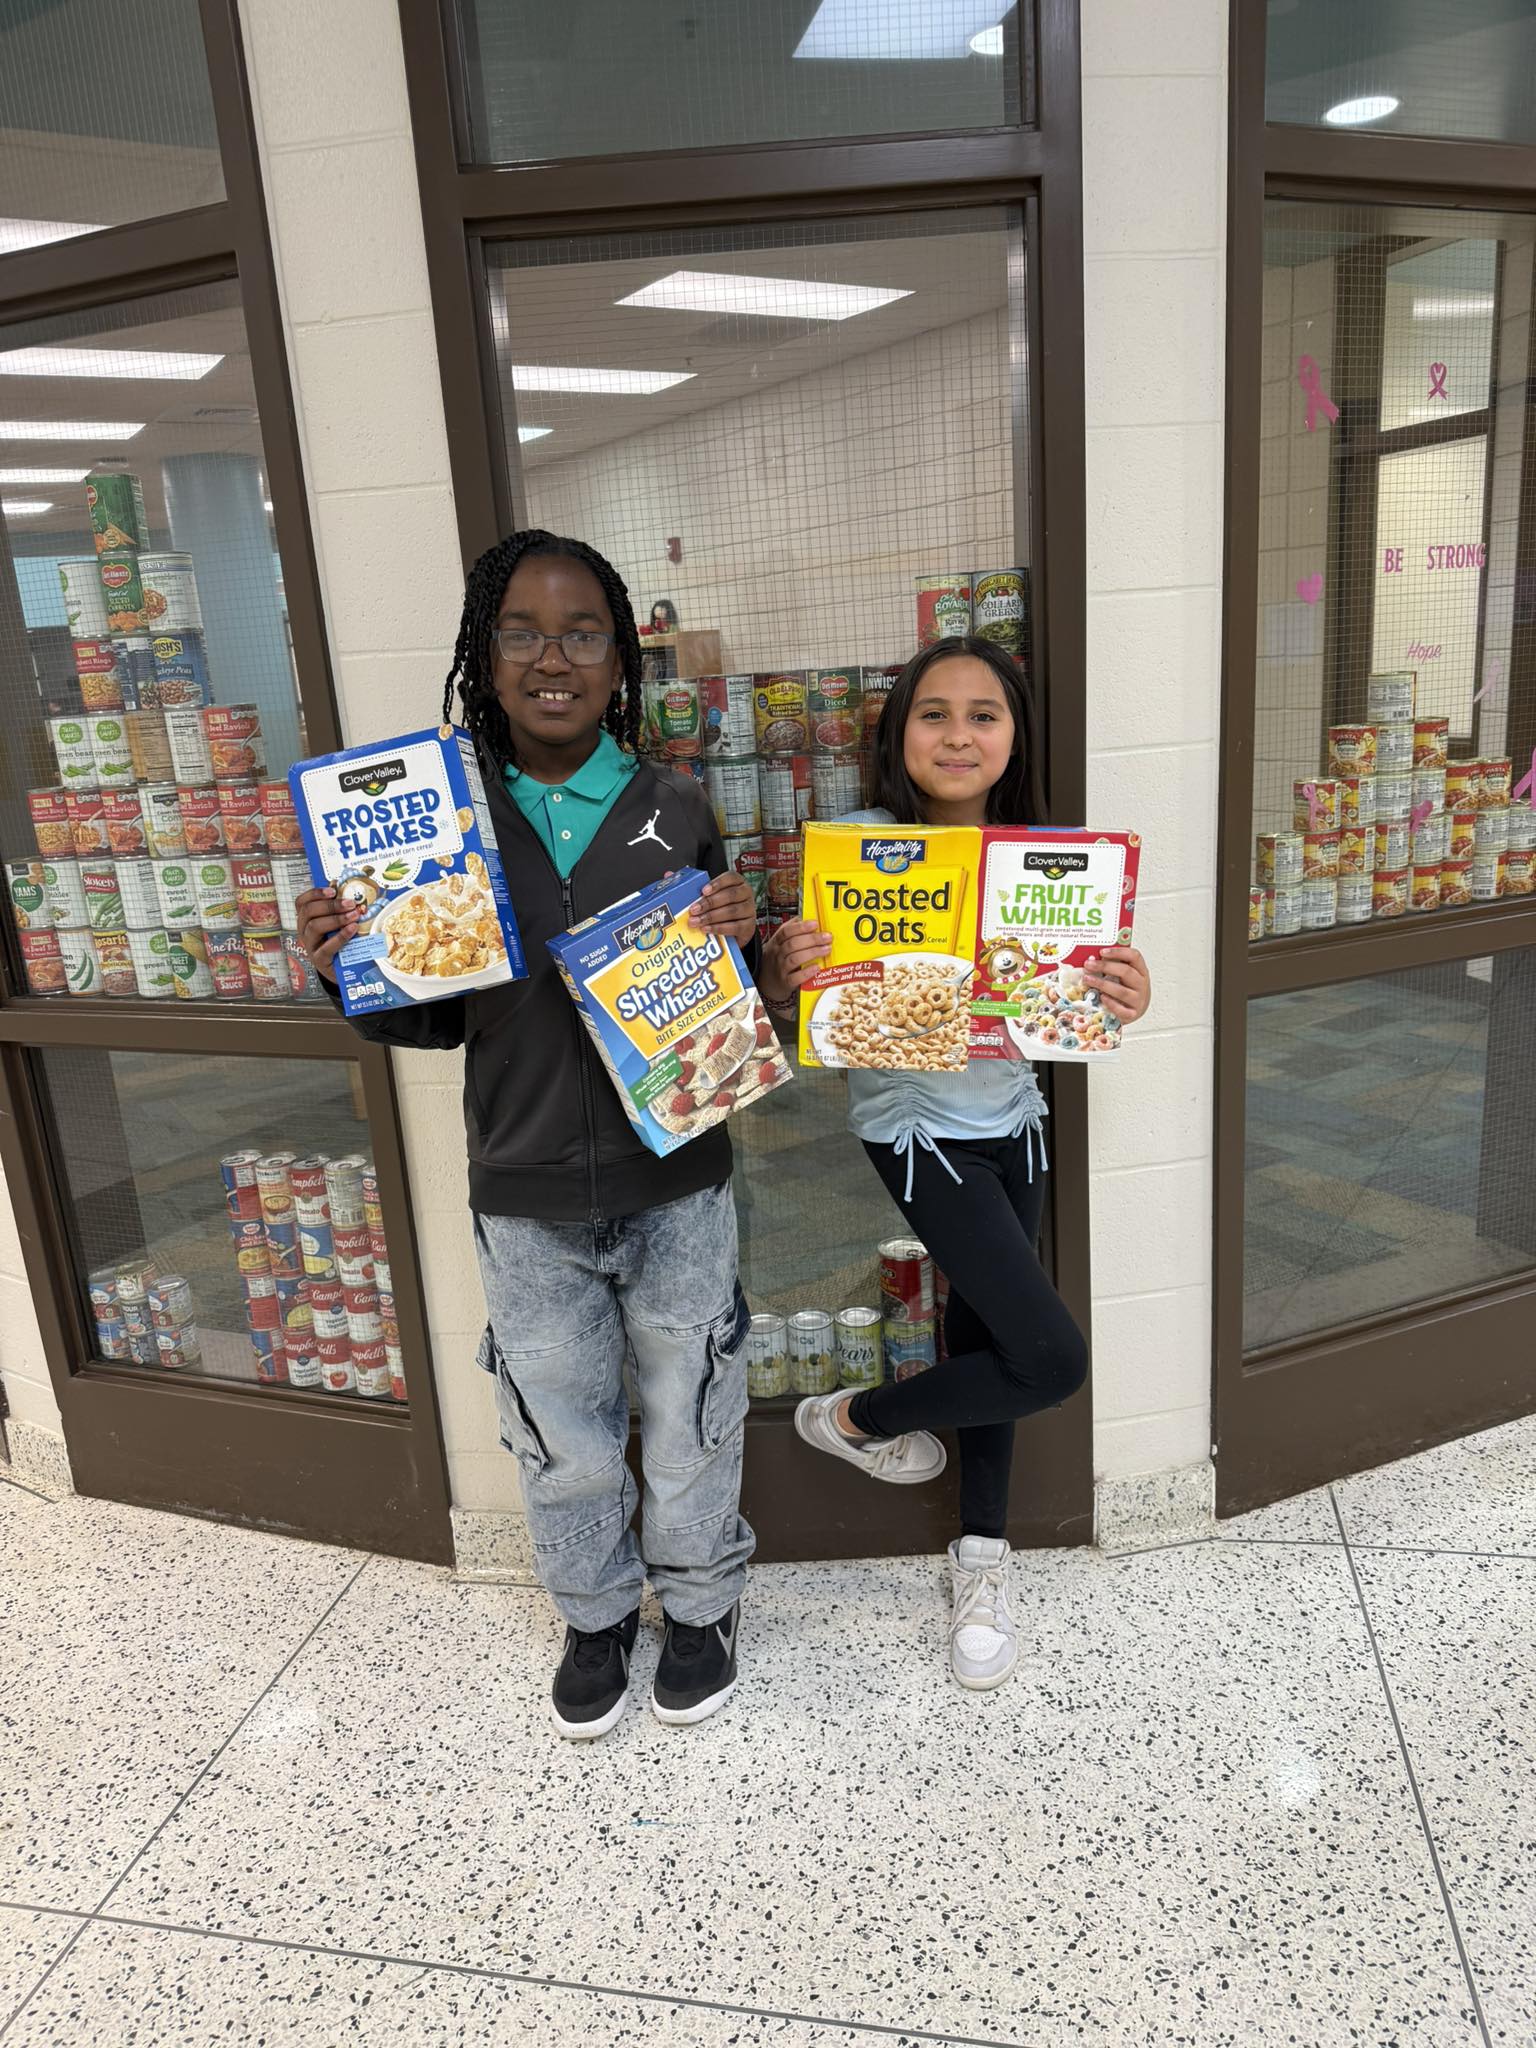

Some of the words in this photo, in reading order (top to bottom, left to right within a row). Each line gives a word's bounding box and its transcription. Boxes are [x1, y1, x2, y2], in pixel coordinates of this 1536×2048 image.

[1384, 548, 1404, 573] BE
[1427, 543, 1487, 571] STRONG
[981, 598, 1023, 610] COLLARD
[984, 607, 1021, 618] GREENS
[1407, 640, 1441, 665] Hope
[864, 676, 897, 690] ANWIC
[824, 698, 847, 706] Diced
[343, 771, 374, 786] Clover
[374, 765, 402, 778] Valley
[322, 788, 440, 836] FROSTED
[337, 815, 438, 859] FLAKES
[778, 853, 796, 861] Beef
[866, 840, 922, 860] Hospitality
[1028, 856, 1057, 866] Clover
[1057, 857, 1084, 868] Valley
[238, 874, 273, 886] Hunt
[14, 886, 37, 896] YAMS
[826, 881, 950, 911] Toasted
[1015, 884, 1094, 905] FRUIT
[1000, 905, 1103, 926] WHIRLS
[621, 907, 667, 946] Hospitality
[854, 914, 925, 943] Oats
[94, 936, 128, 948] osarit
[579, 955, 590, 964] NO
[589, 944, 609, 959] SUGAR
[587, 954, 608, 968] ADDED
[631, 933, 686, 978] Original
[617, 933, 722, 1020] Shredded
[812, 976, 840, 987] Vitamins
[840, 972, 853, 980] and
[853, 970, 881, 978] Minerals
[815, 968, 833, 979] Good
[833, 964, 854, 975] Source
[863, 962, 872, 970] 12
[220, 981, 244, 990] Sauce
[643, 970, 717, 1029] Wheat
[656, 1028, 676, 1045] BITE
[676, 1016, 696, 1032] SIZE
[695, 991, 727, 1017] CEREAL
[291, 1174, 326, 1188] ampbell
[335, 1234, 370, 1249] ampbell's
[353, 1345, 385, 1361] mpbell's
